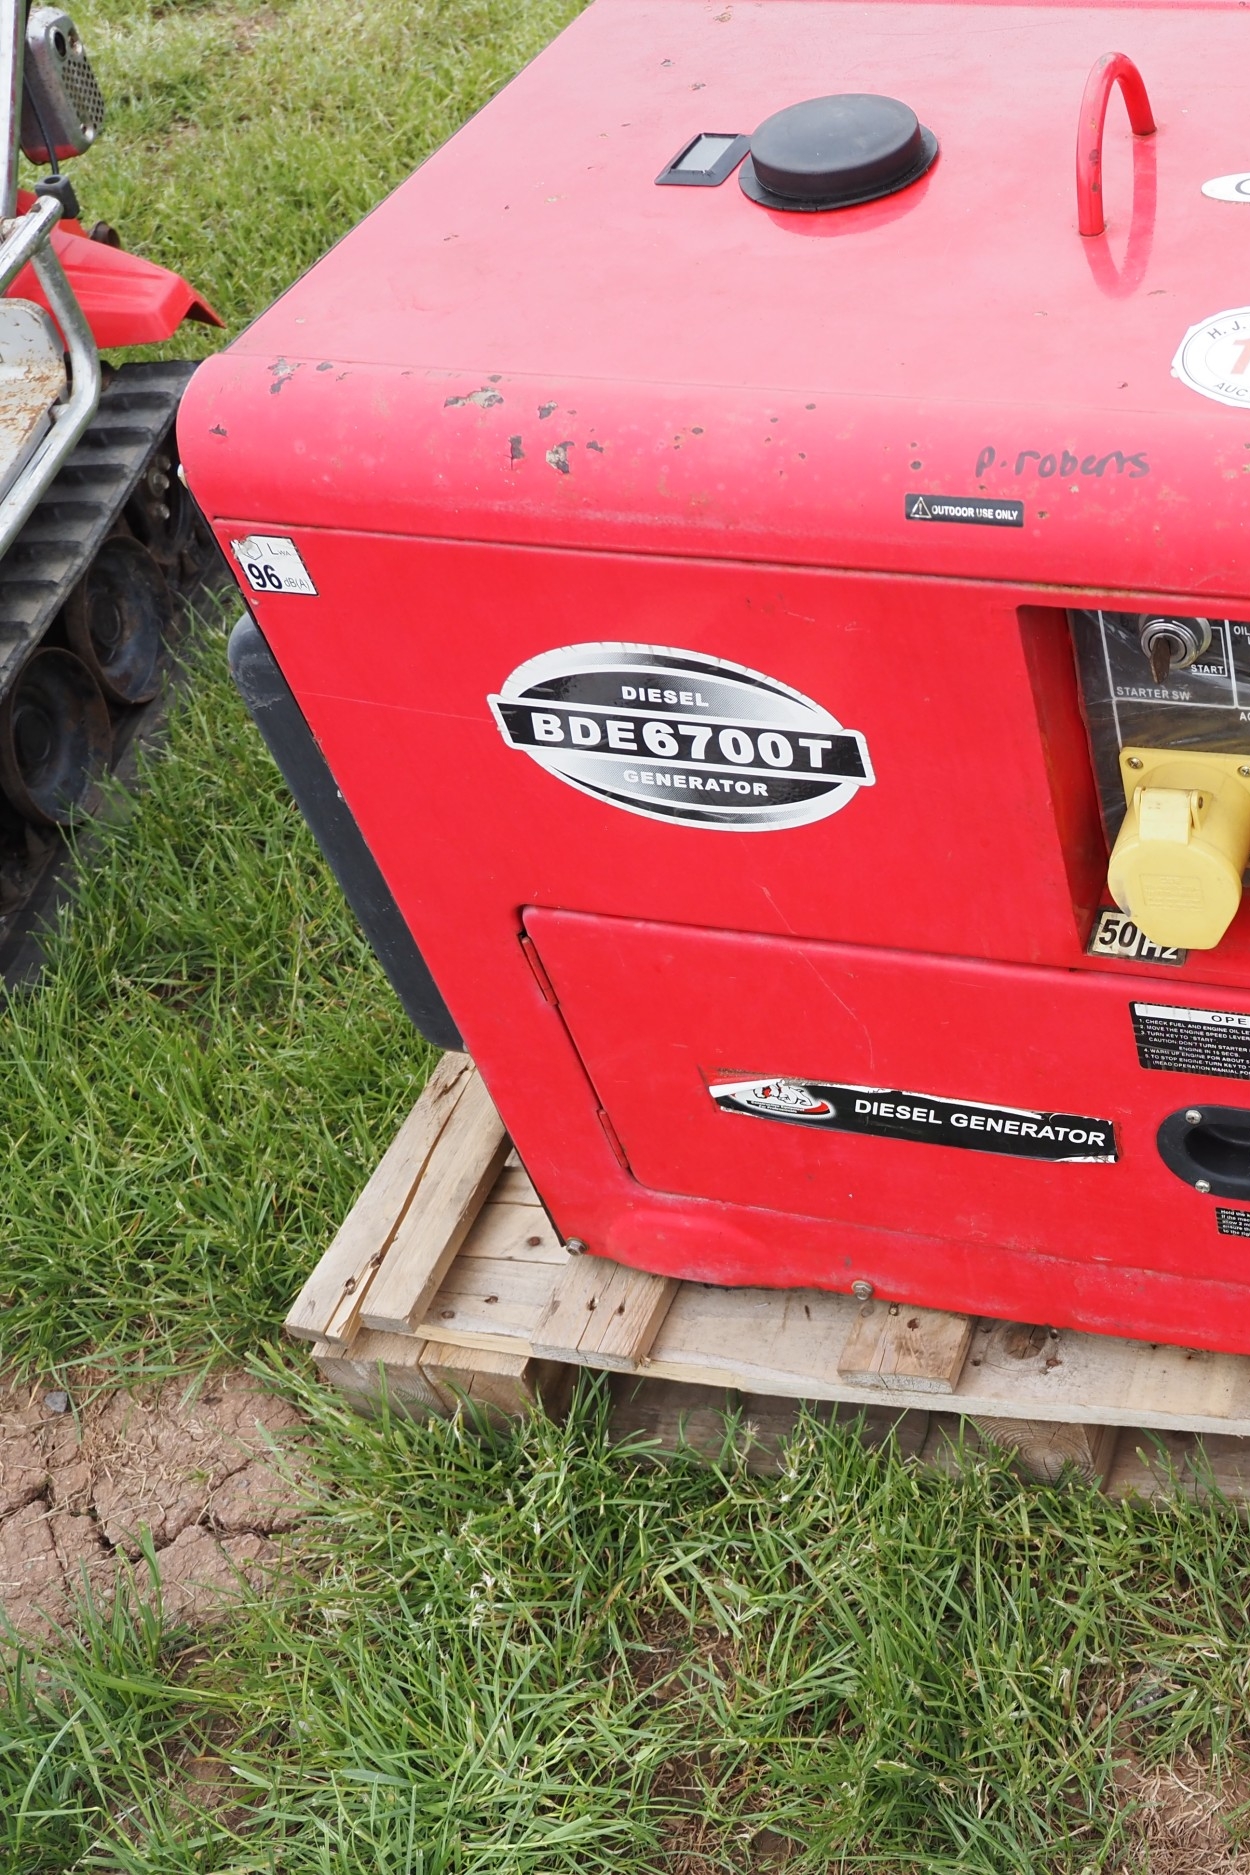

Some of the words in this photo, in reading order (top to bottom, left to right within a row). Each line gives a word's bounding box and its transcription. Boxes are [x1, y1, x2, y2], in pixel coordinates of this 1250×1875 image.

[1207, 328, 1227, 340] H.
[1232, 321, 1246, 331] J.
[932, 505, 974, 517] OUTDOOR
[976, 507, 993, 518] USE
[996, 509, 1018, 520] ONLY
[248, 563, 282, 589] 96
[284, 578, 310, 591] dB(A)
[1234, 626, 1250, 635] OIL
[1190, 665, 1224, 674] START
[622, 686, 709, 707] DIESEL
[1117, 687, 1169, 698] STARTER
[1172, 691, 1190, 700] SW
[530, 712, 832, 768] BDE6700T
[623, 769, 768, 797] GENERATOR
[1099, 919, 1138, 947] 50
[1174, 1063, 1210, 1071] OPERATION
[854, 1099, 943, 1125] DIESEL
[950, 1113, 1106, 1147] GENERATOR
